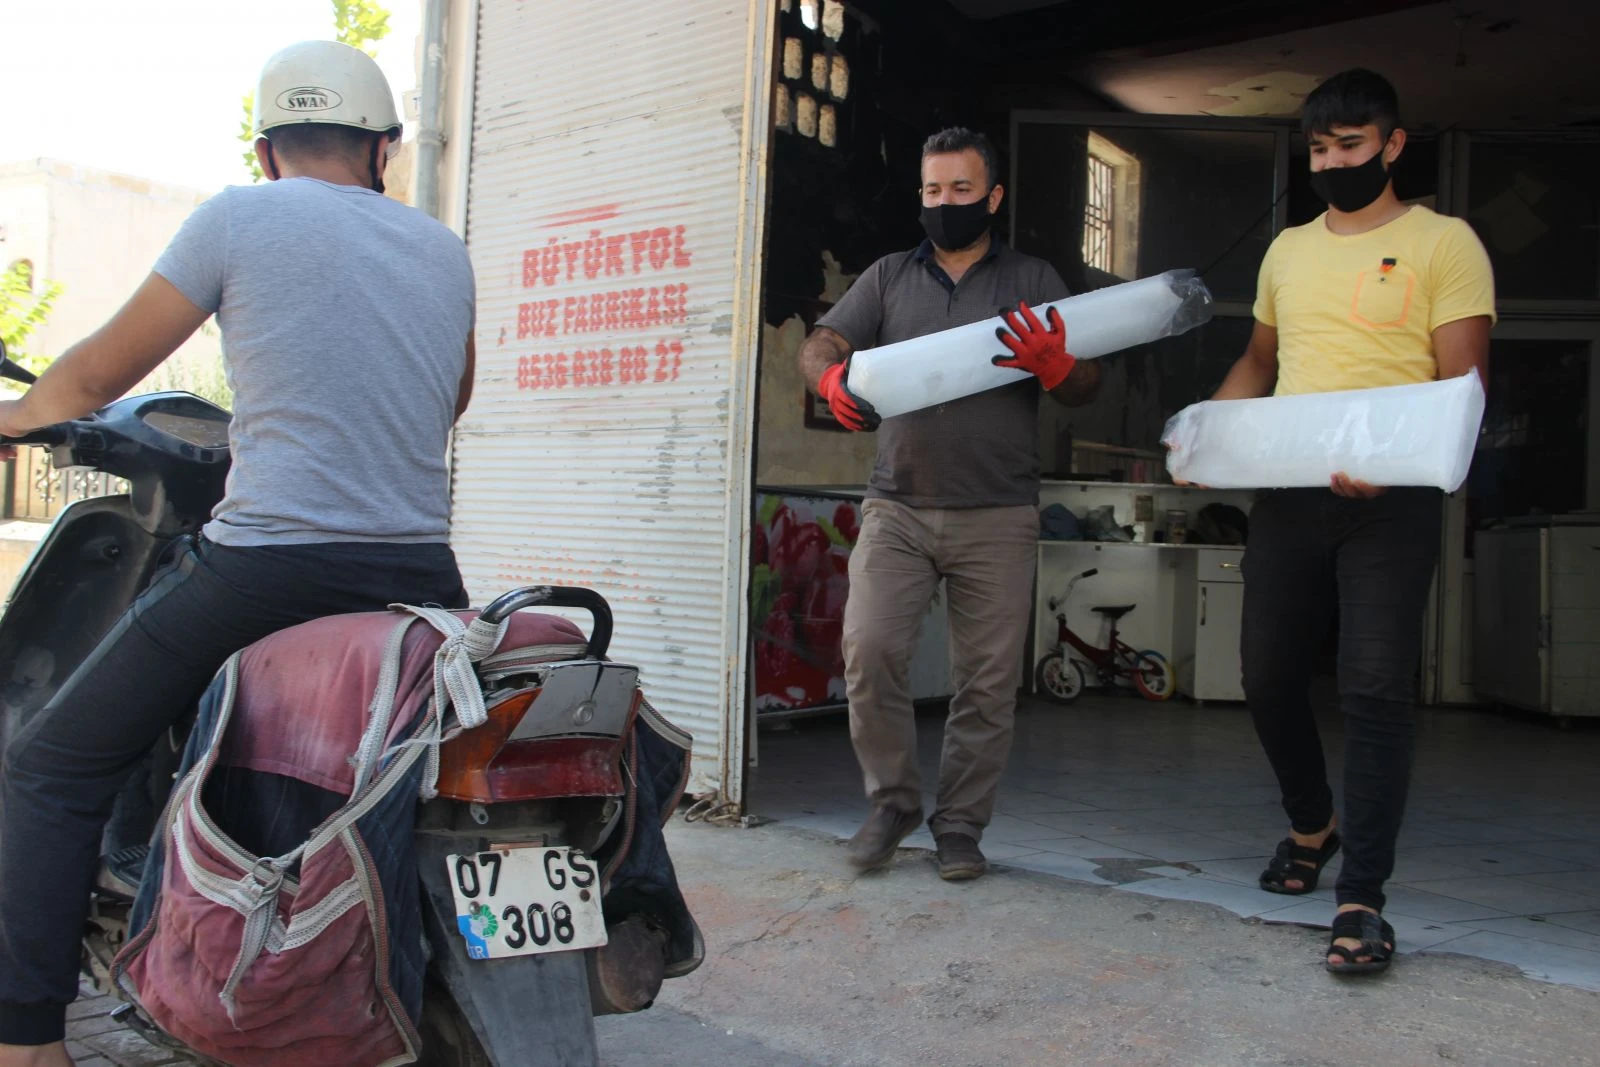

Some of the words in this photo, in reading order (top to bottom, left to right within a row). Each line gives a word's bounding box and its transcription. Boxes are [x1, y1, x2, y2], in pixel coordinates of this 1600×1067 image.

[288, 97, 328, 109] SWAN
[653, 338, 684, 383] 27
[456, 853, 501, 898] 07
[544, 850, 595, 891] GS
[502, 901, 574, 949] 308
